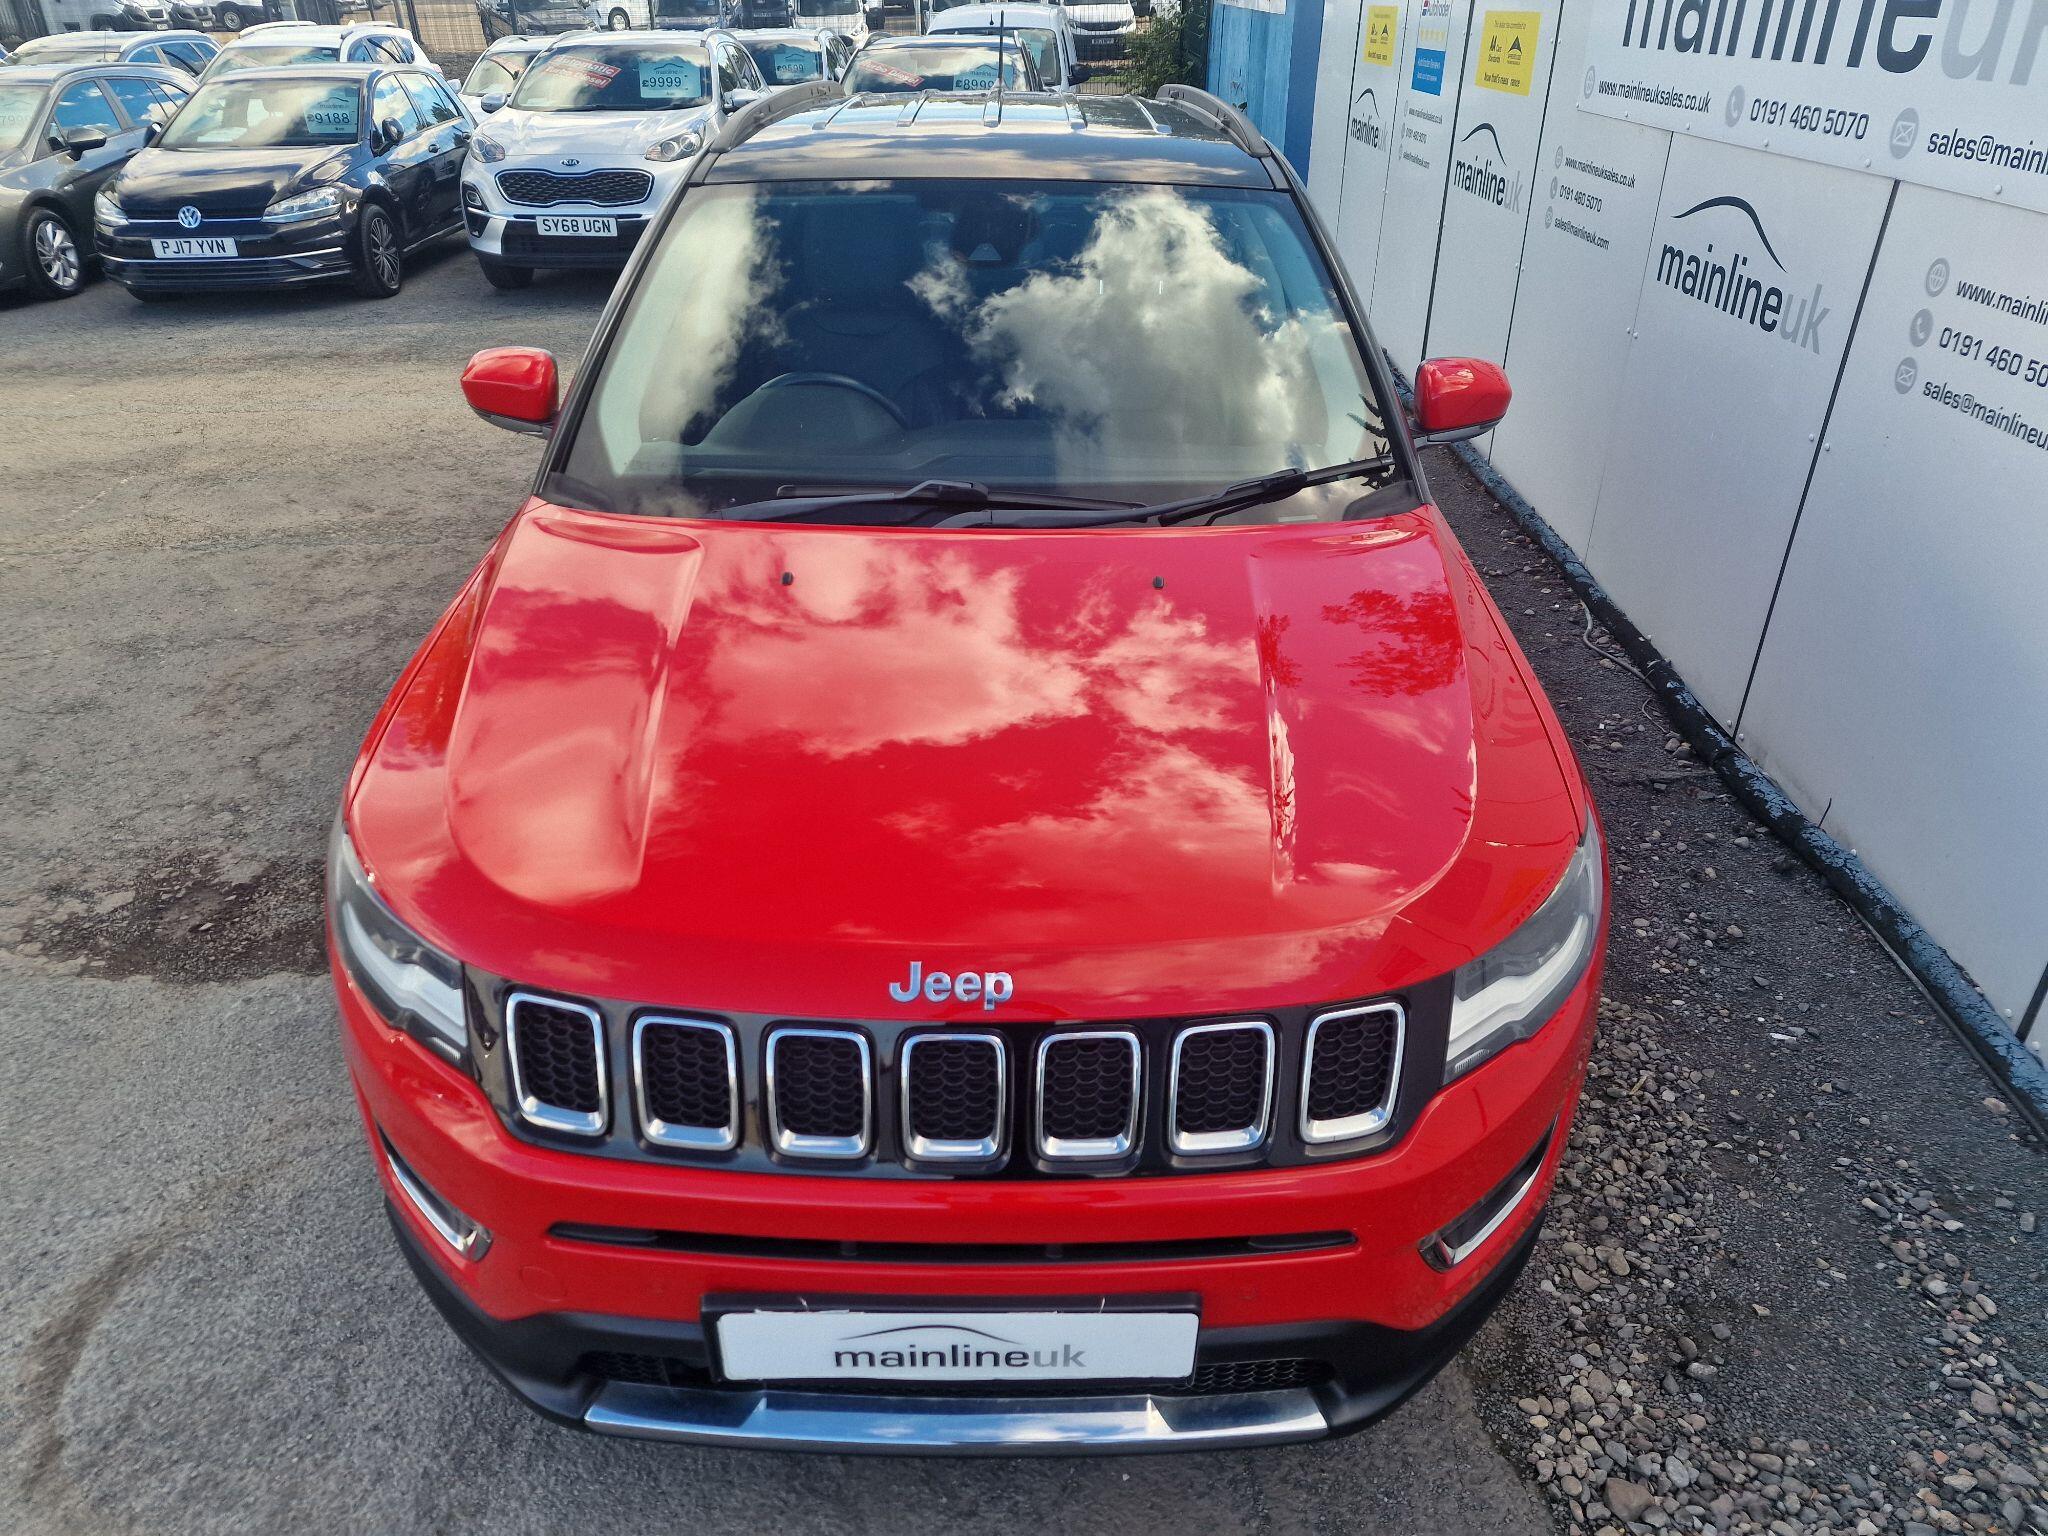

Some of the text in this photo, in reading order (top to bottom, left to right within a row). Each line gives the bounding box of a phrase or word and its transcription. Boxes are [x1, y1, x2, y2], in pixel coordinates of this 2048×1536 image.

[642, 76, 682, 88] £9999
[1599, 80, 1712, 113] www.mainlineuksales.co.uk
[1750, 98, 1787, 127] 0191
[1790, 104, 1822, 131] 460
[1824, 108, 1870, 140] 5070
[1454, 155, 1523, 214] mainlineuk
[1564, 157, 1635, 188] www.mainlineuksales.co.uk
[1560, 185, 1602, 212] 0191 460 5070
[543, 219, 612, 233] SY68 UGN
[161, 240, 226, 255] PJ17 YVN
[1657, 243, 1831, 355] mainlineuk
[1939, 326, 1983, 361] 0191
[1986, 346, 2023, 376] 460
[889, 961, 1014, 1011] Jeep
[834, 1344, 1087, 1368] mainlineuk
